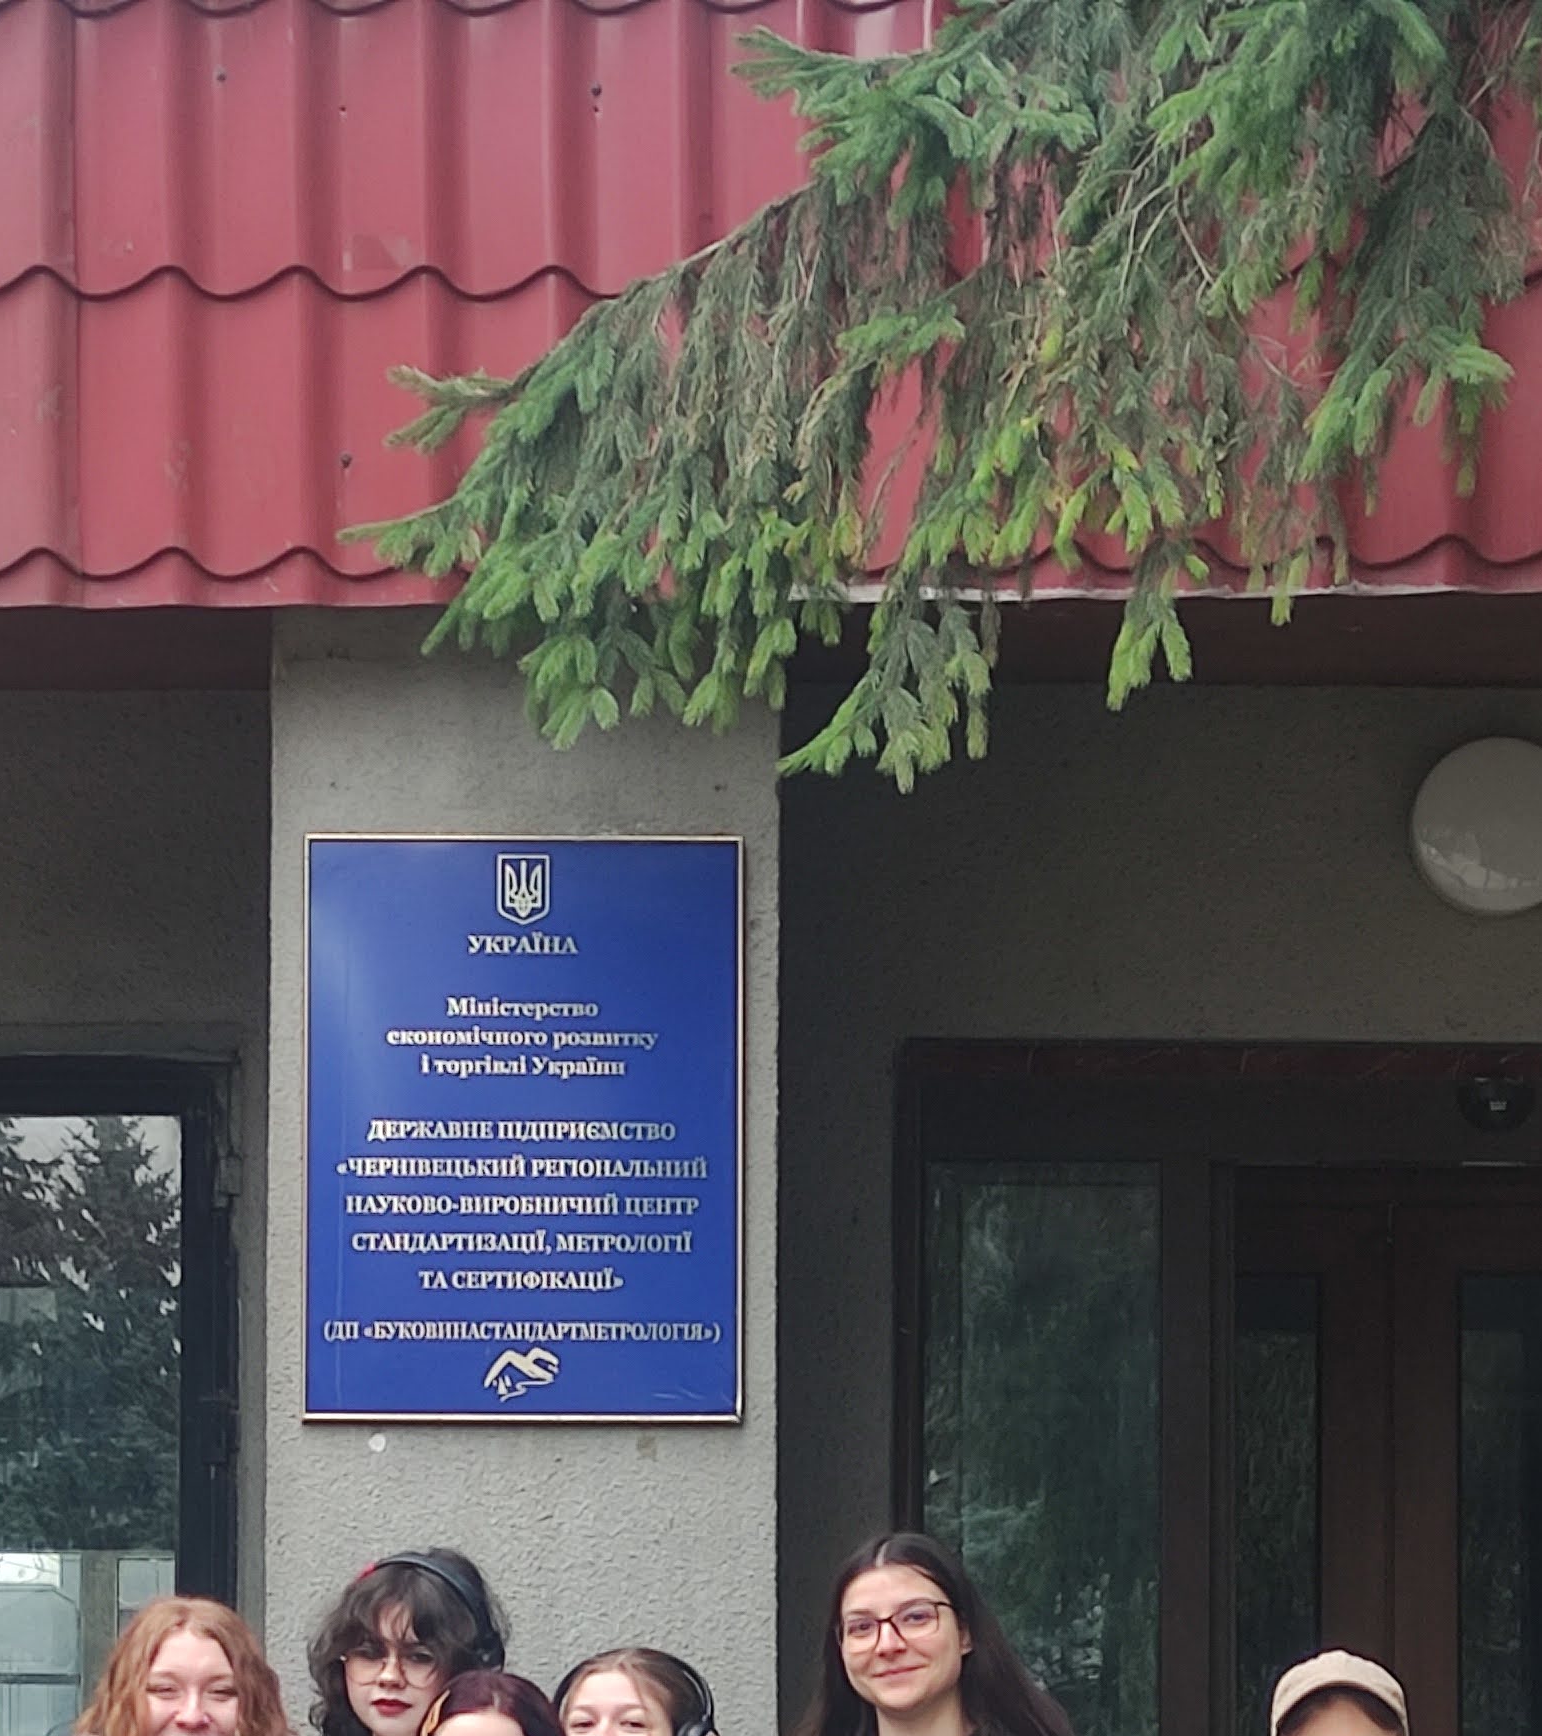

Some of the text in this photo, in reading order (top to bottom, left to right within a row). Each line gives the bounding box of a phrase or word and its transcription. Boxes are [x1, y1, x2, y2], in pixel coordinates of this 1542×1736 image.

[467, 932, 579, 955] УКРАЇНА
[446, 997, 599, 1022] Міністерство
[386, 1026, 659, 1051] економічного розвитку
[421, 1055, 625, 1079] і торгівлі України
[366, 1120, 676, 1142] ДЕРЖАВНЕ ПІДПРИЄМСТВО
[336, 1154, 707, 1179] «ЧЕРНІВЕЦЬКИЙ РЕГІОНАЛЬНИЙ
[345, 1193, 700, 1217] НАУКОВО-ВИРОБНИЧИЙ ЦЕНТР
[351, 1230, 692, 1255] СТАНДАРТИЗАЦІЇ, МЕТРОЛОГІЇ
[418, 1268, 624, 1292] ТА СЕРТИФІКАЦІЇ»
[323, 1321, 360, 1343] (ДП
